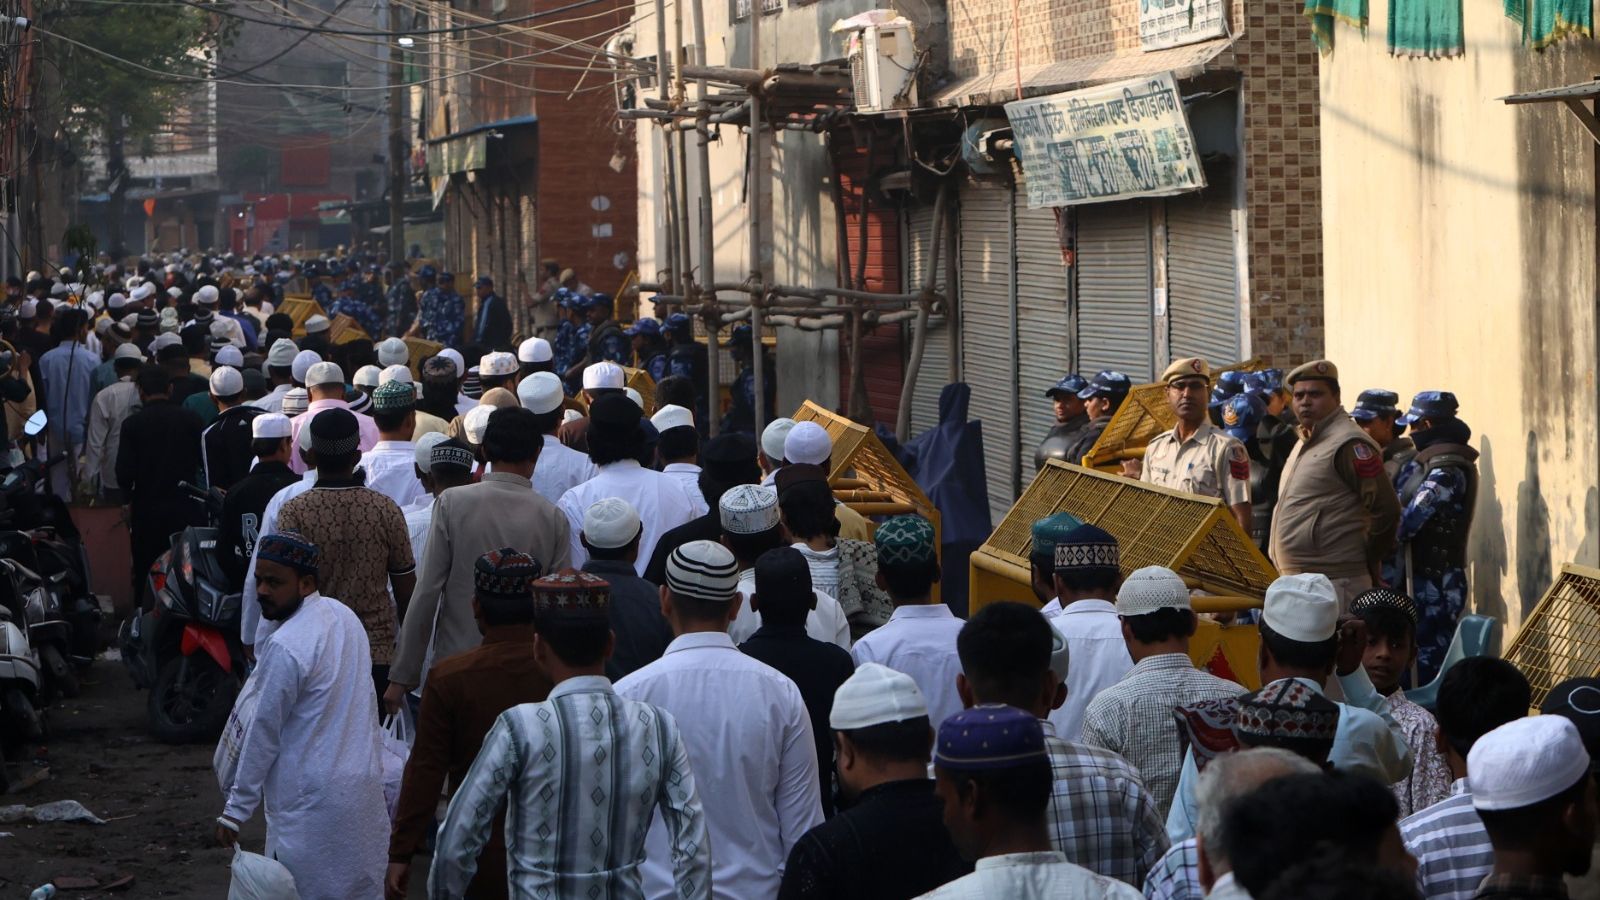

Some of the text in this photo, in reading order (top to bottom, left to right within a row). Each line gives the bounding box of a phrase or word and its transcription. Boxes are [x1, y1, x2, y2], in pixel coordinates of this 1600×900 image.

[1108, 100, 1128, 125] एण्ड
[1098, 153, 1117, 193] 90
[1132, 148, 1154, 189] 30
